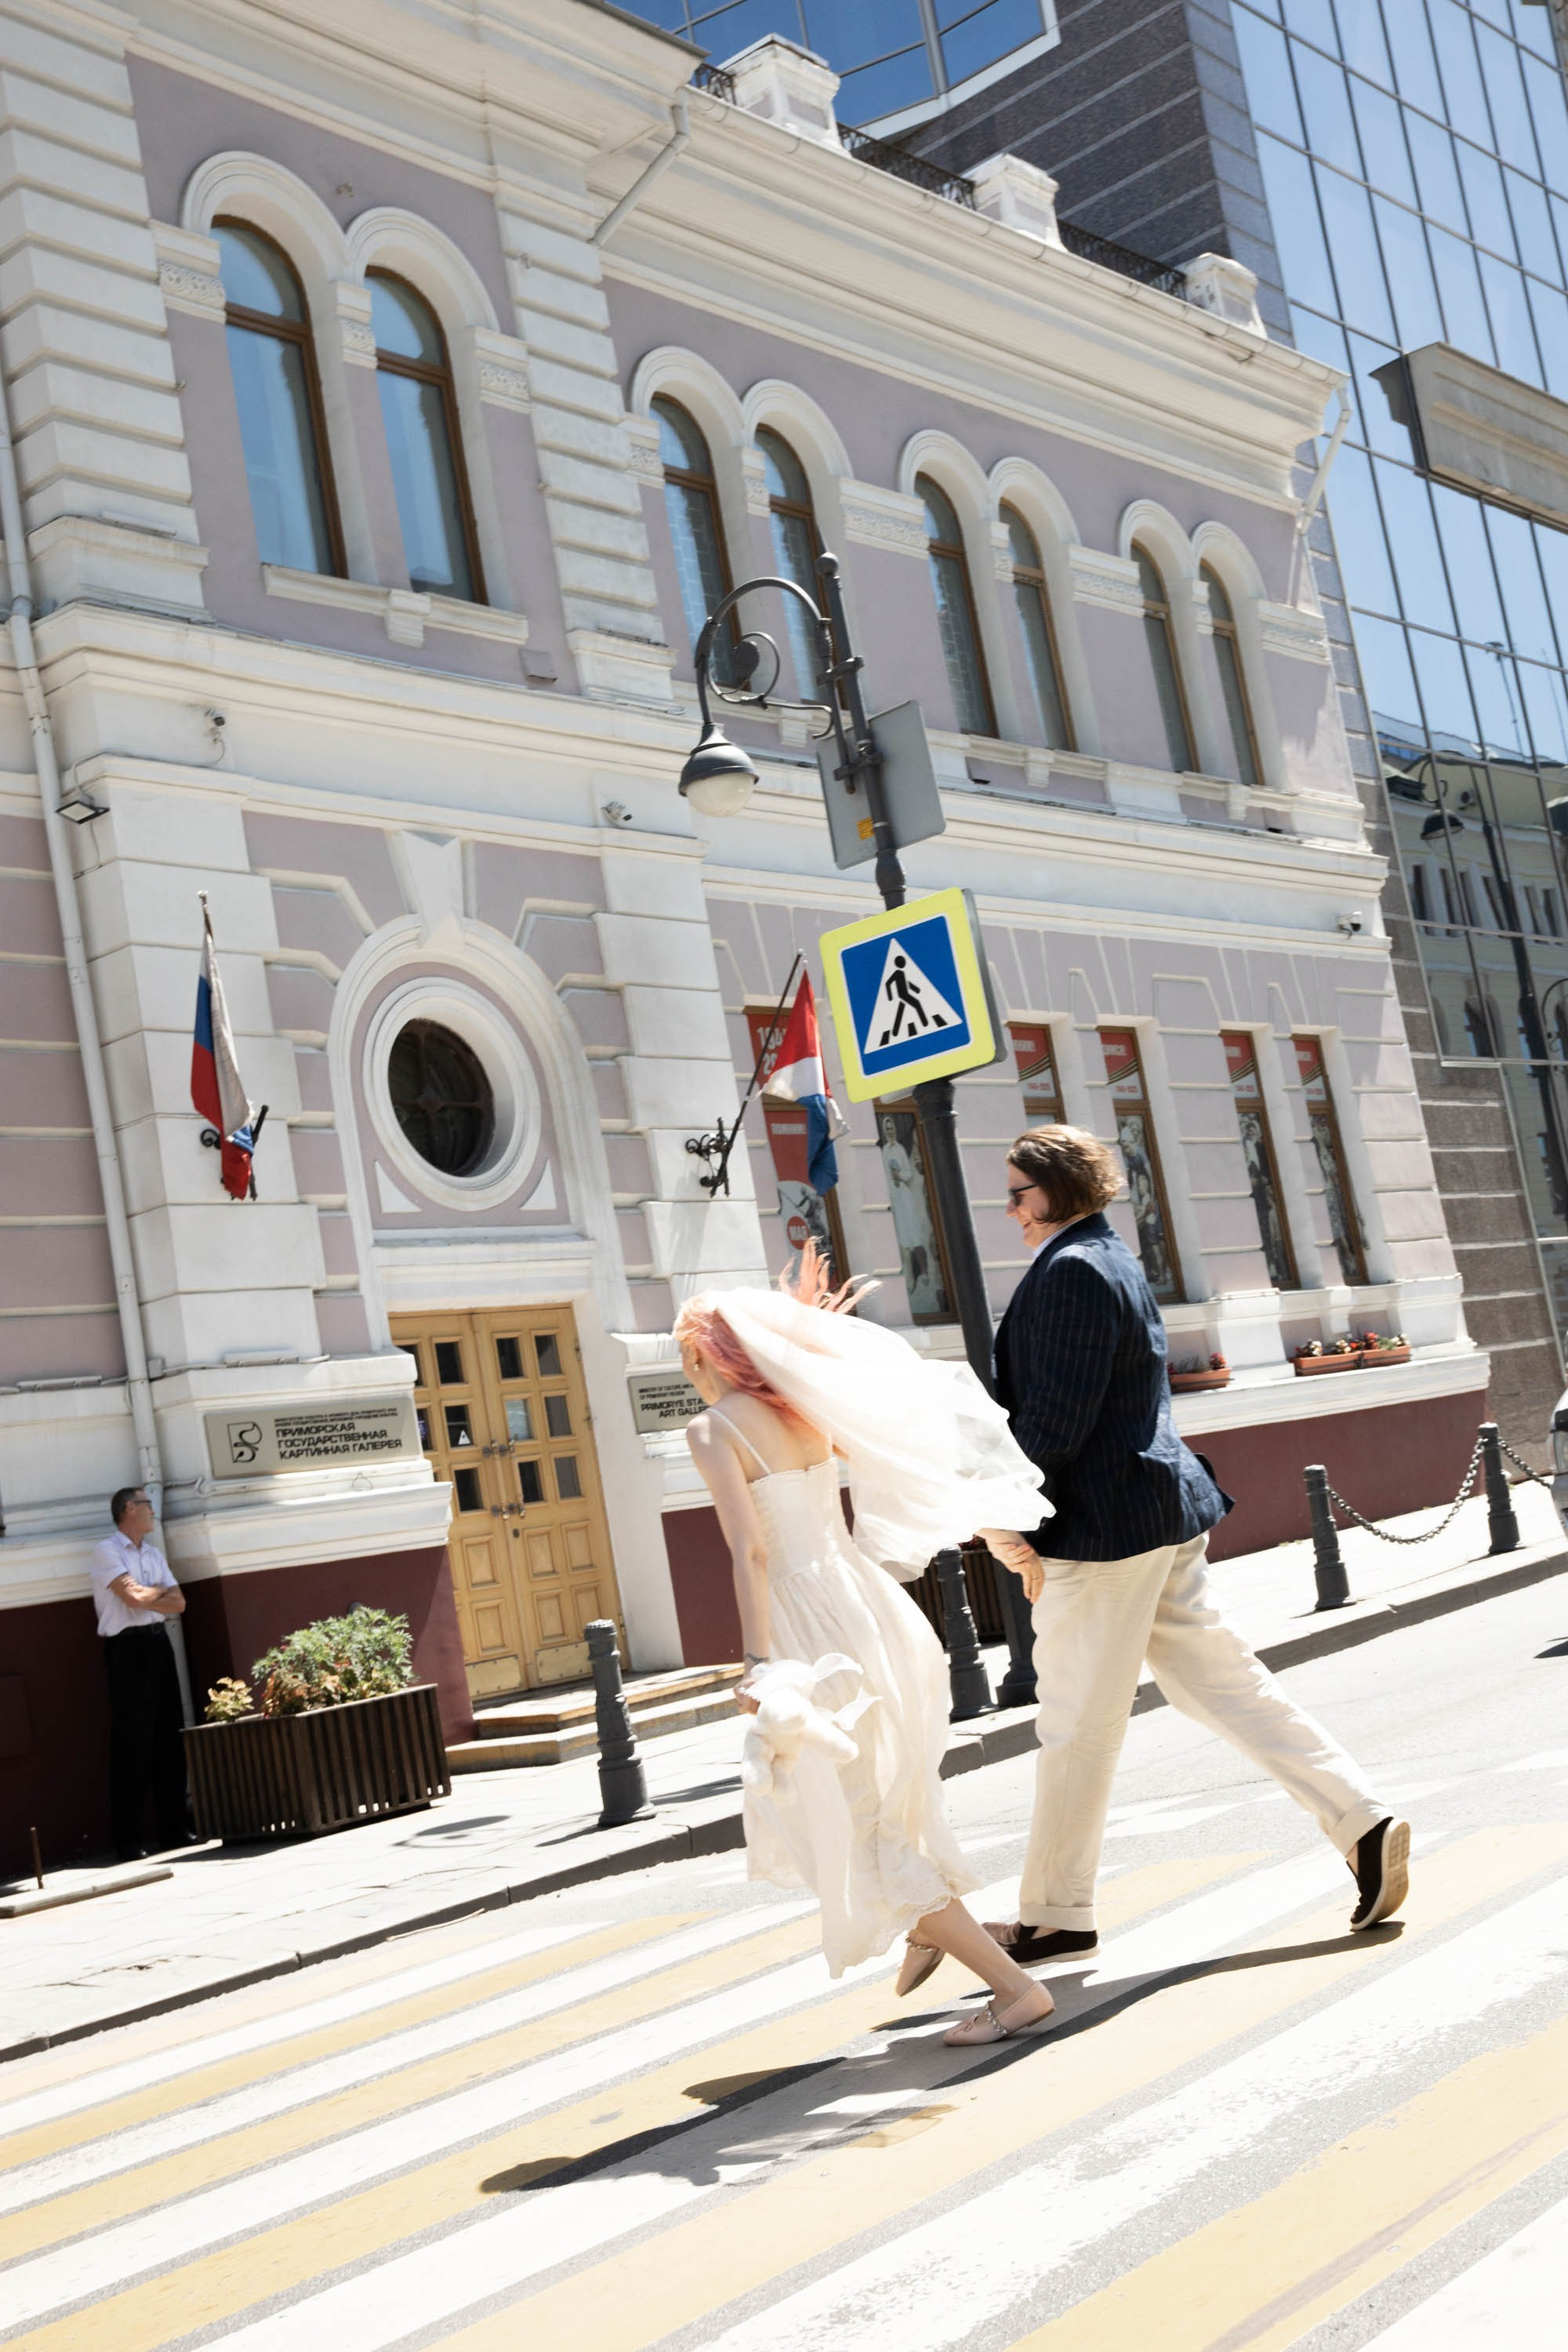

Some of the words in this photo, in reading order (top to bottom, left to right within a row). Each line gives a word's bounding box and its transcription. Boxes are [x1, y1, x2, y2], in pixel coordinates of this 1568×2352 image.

[641, 1399, 684, 1411] PRIMORYE
[659, 1409, 675, 1418] ART
[276, 1422, 355, 1438] ПРИМОРСКАЯ
[278, 1429, 387, 1449] ГОСУДАРСТВЕННАЯ
[279, 1445, 350, 1460] КАРТИННАЯ
[352, 1439, 402, 1454] ГАЛЕРЕЯ
